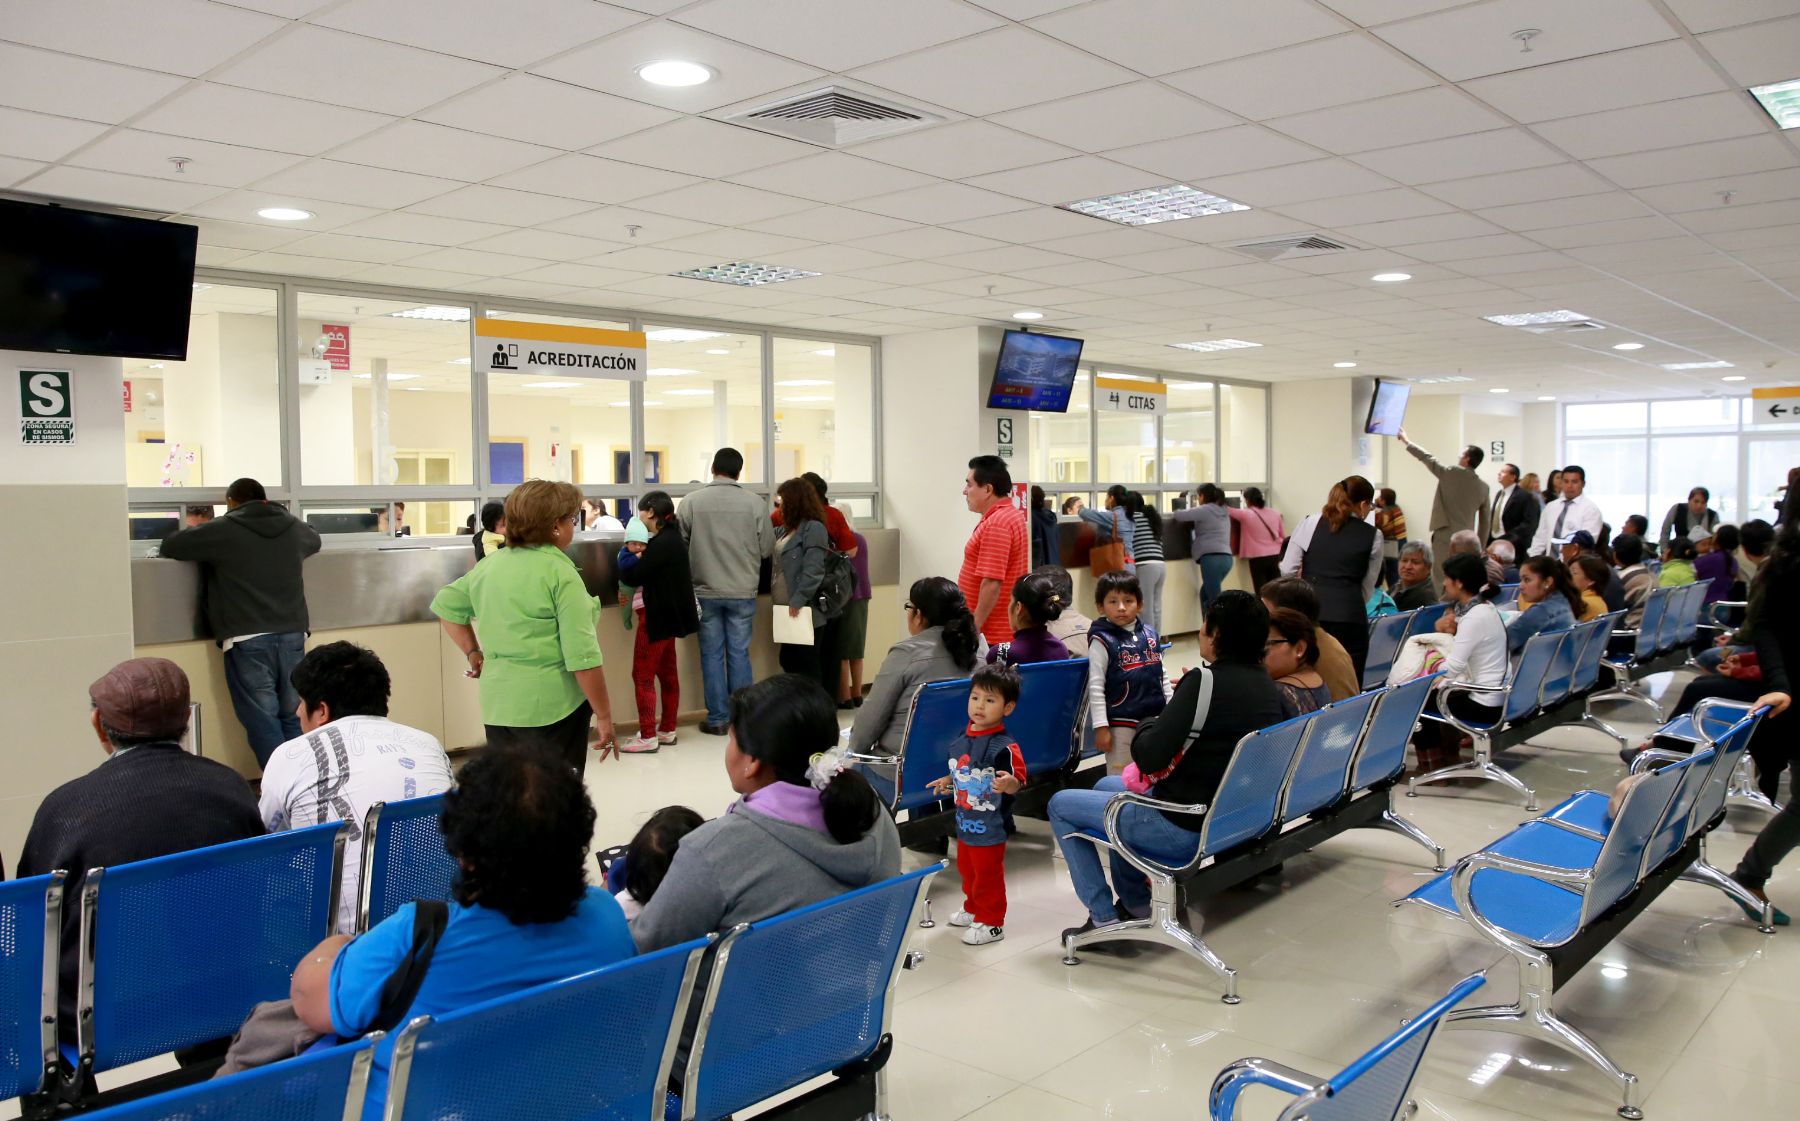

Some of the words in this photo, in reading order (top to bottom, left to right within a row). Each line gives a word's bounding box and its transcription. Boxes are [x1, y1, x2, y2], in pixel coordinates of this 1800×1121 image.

[527, 351, 637, 371] ACREDITACIÓN
[29, 373, 65, 416] S
[1128, 395, 1155, 410] CITAS
[1000, 420, 1011, 443] S
[1492, 441, 1503, 455] S
